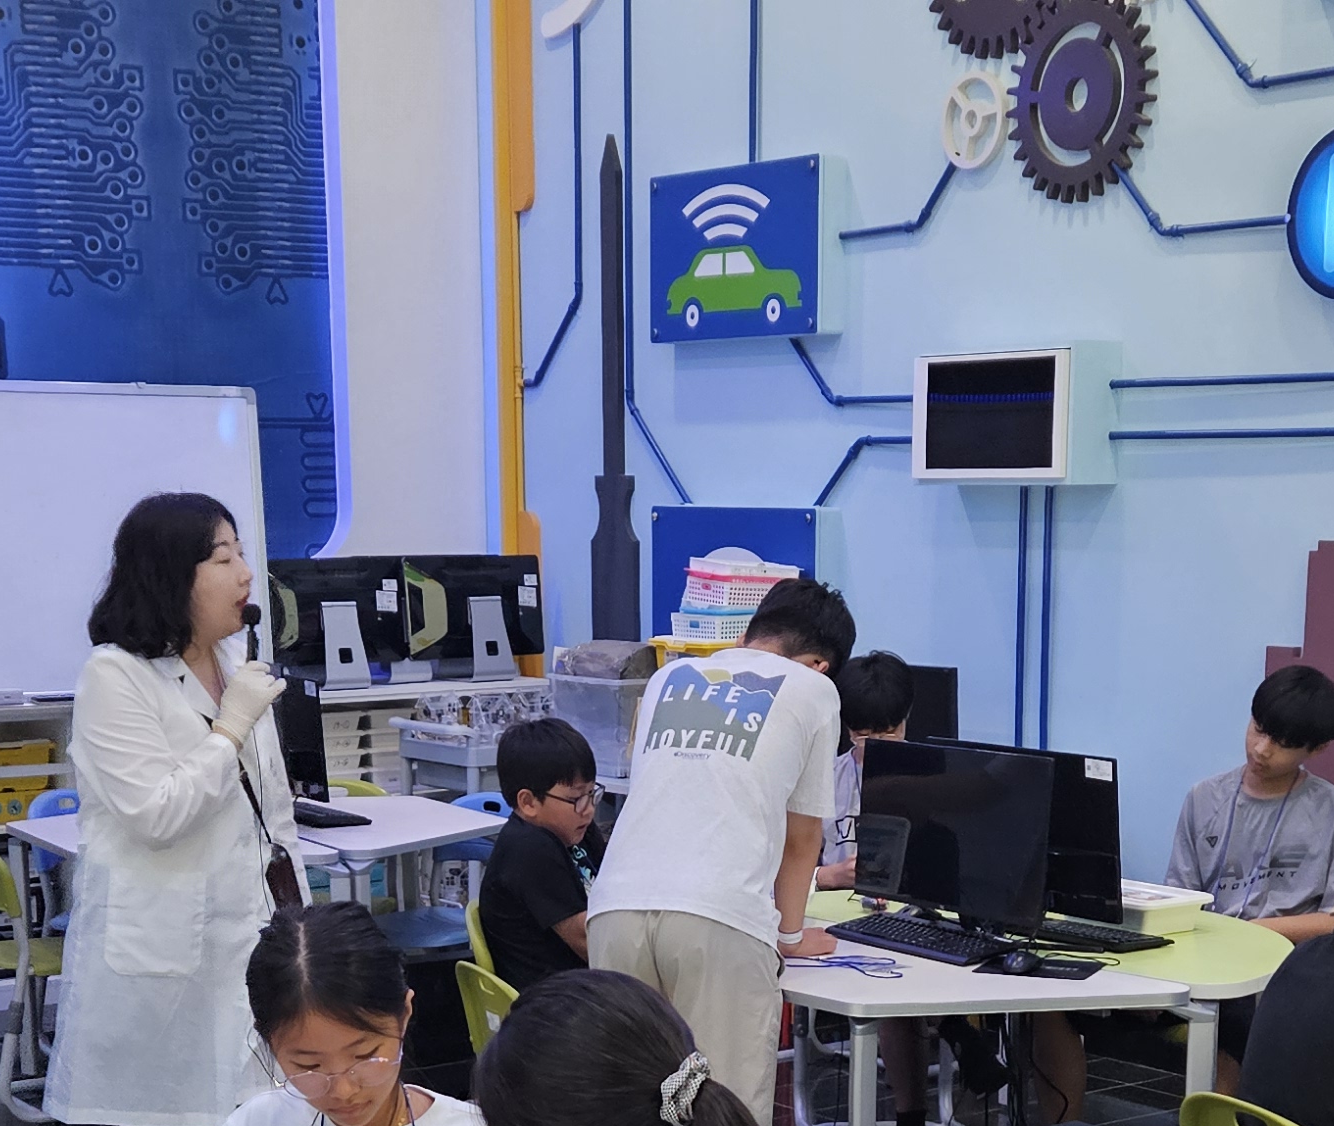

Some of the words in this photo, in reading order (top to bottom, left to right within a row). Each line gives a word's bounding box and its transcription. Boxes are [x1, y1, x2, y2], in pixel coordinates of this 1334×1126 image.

[662, 683, 743, 704] LIFE
[724, 707, 764, 733] IS
[645, 728, 750, 760] JOYFUL
[674, 750, 712, 761] Discovery
[1217, 870, 1298, 891] MOVEMENT
